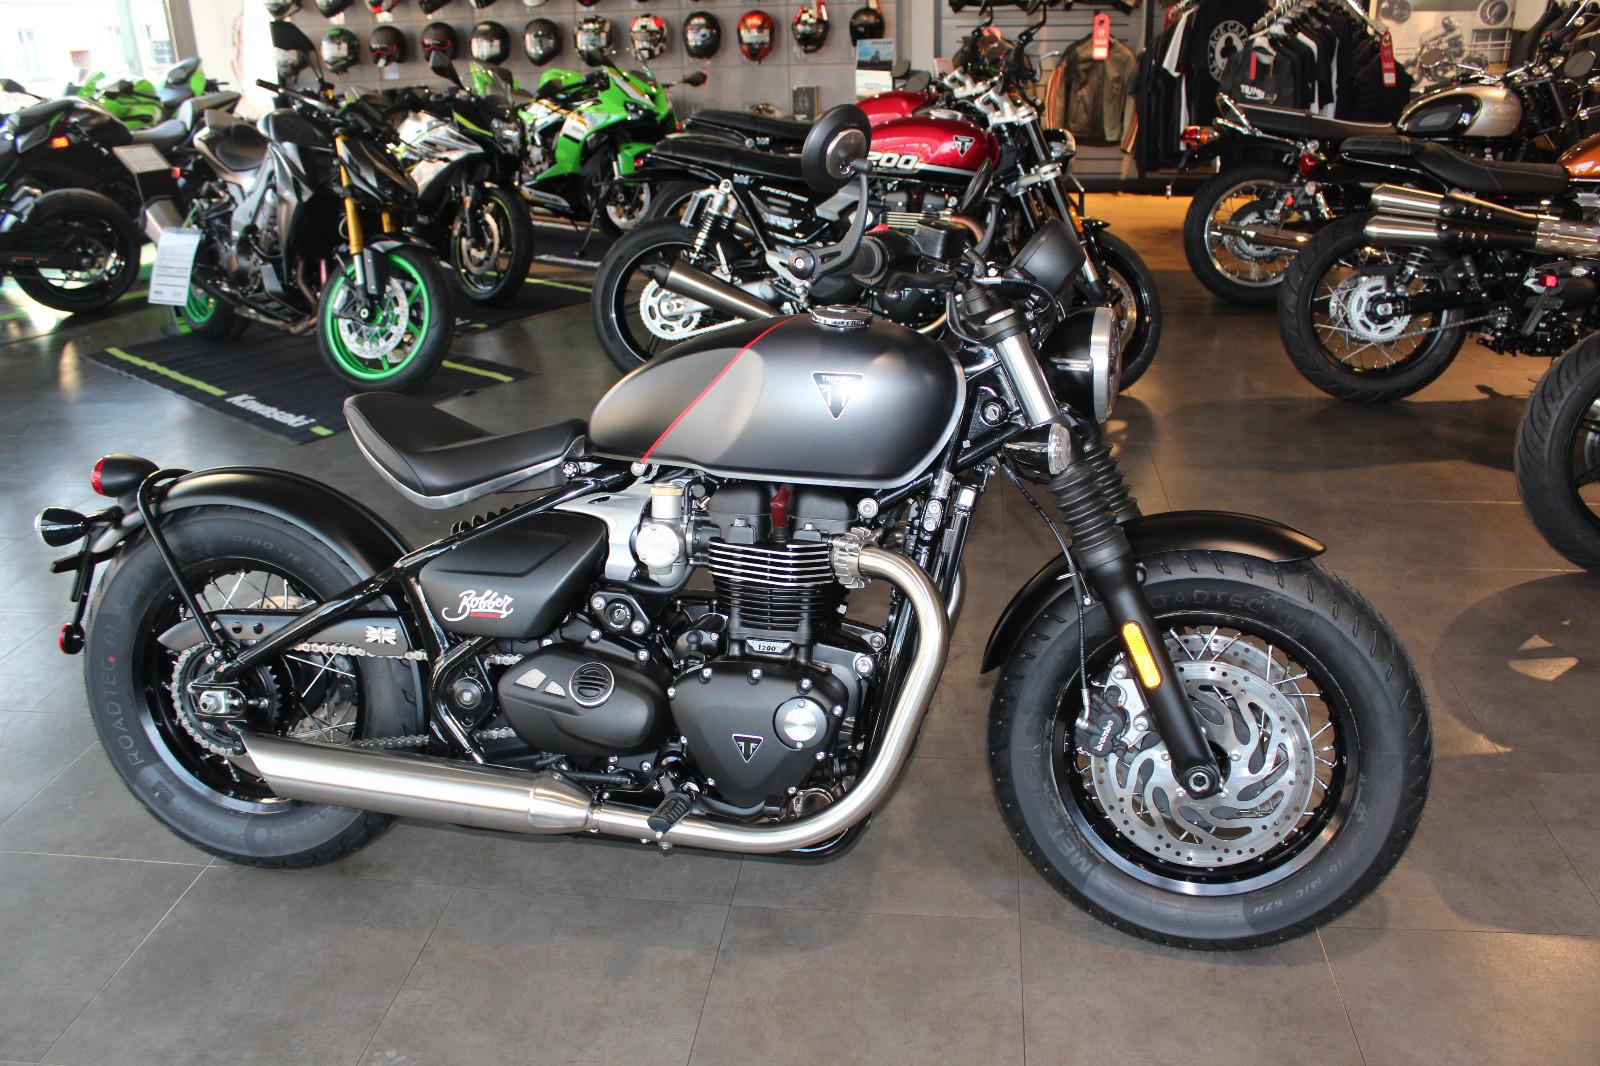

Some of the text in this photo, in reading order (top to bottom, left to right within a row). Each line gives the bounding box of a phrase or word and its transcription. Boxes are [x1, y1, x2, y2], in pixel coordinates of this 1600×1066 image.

[441, 589, 515, 622] Bobber
[758, 644, 777, 652] 1200
[1093, 719, 1114, 752] brembo
